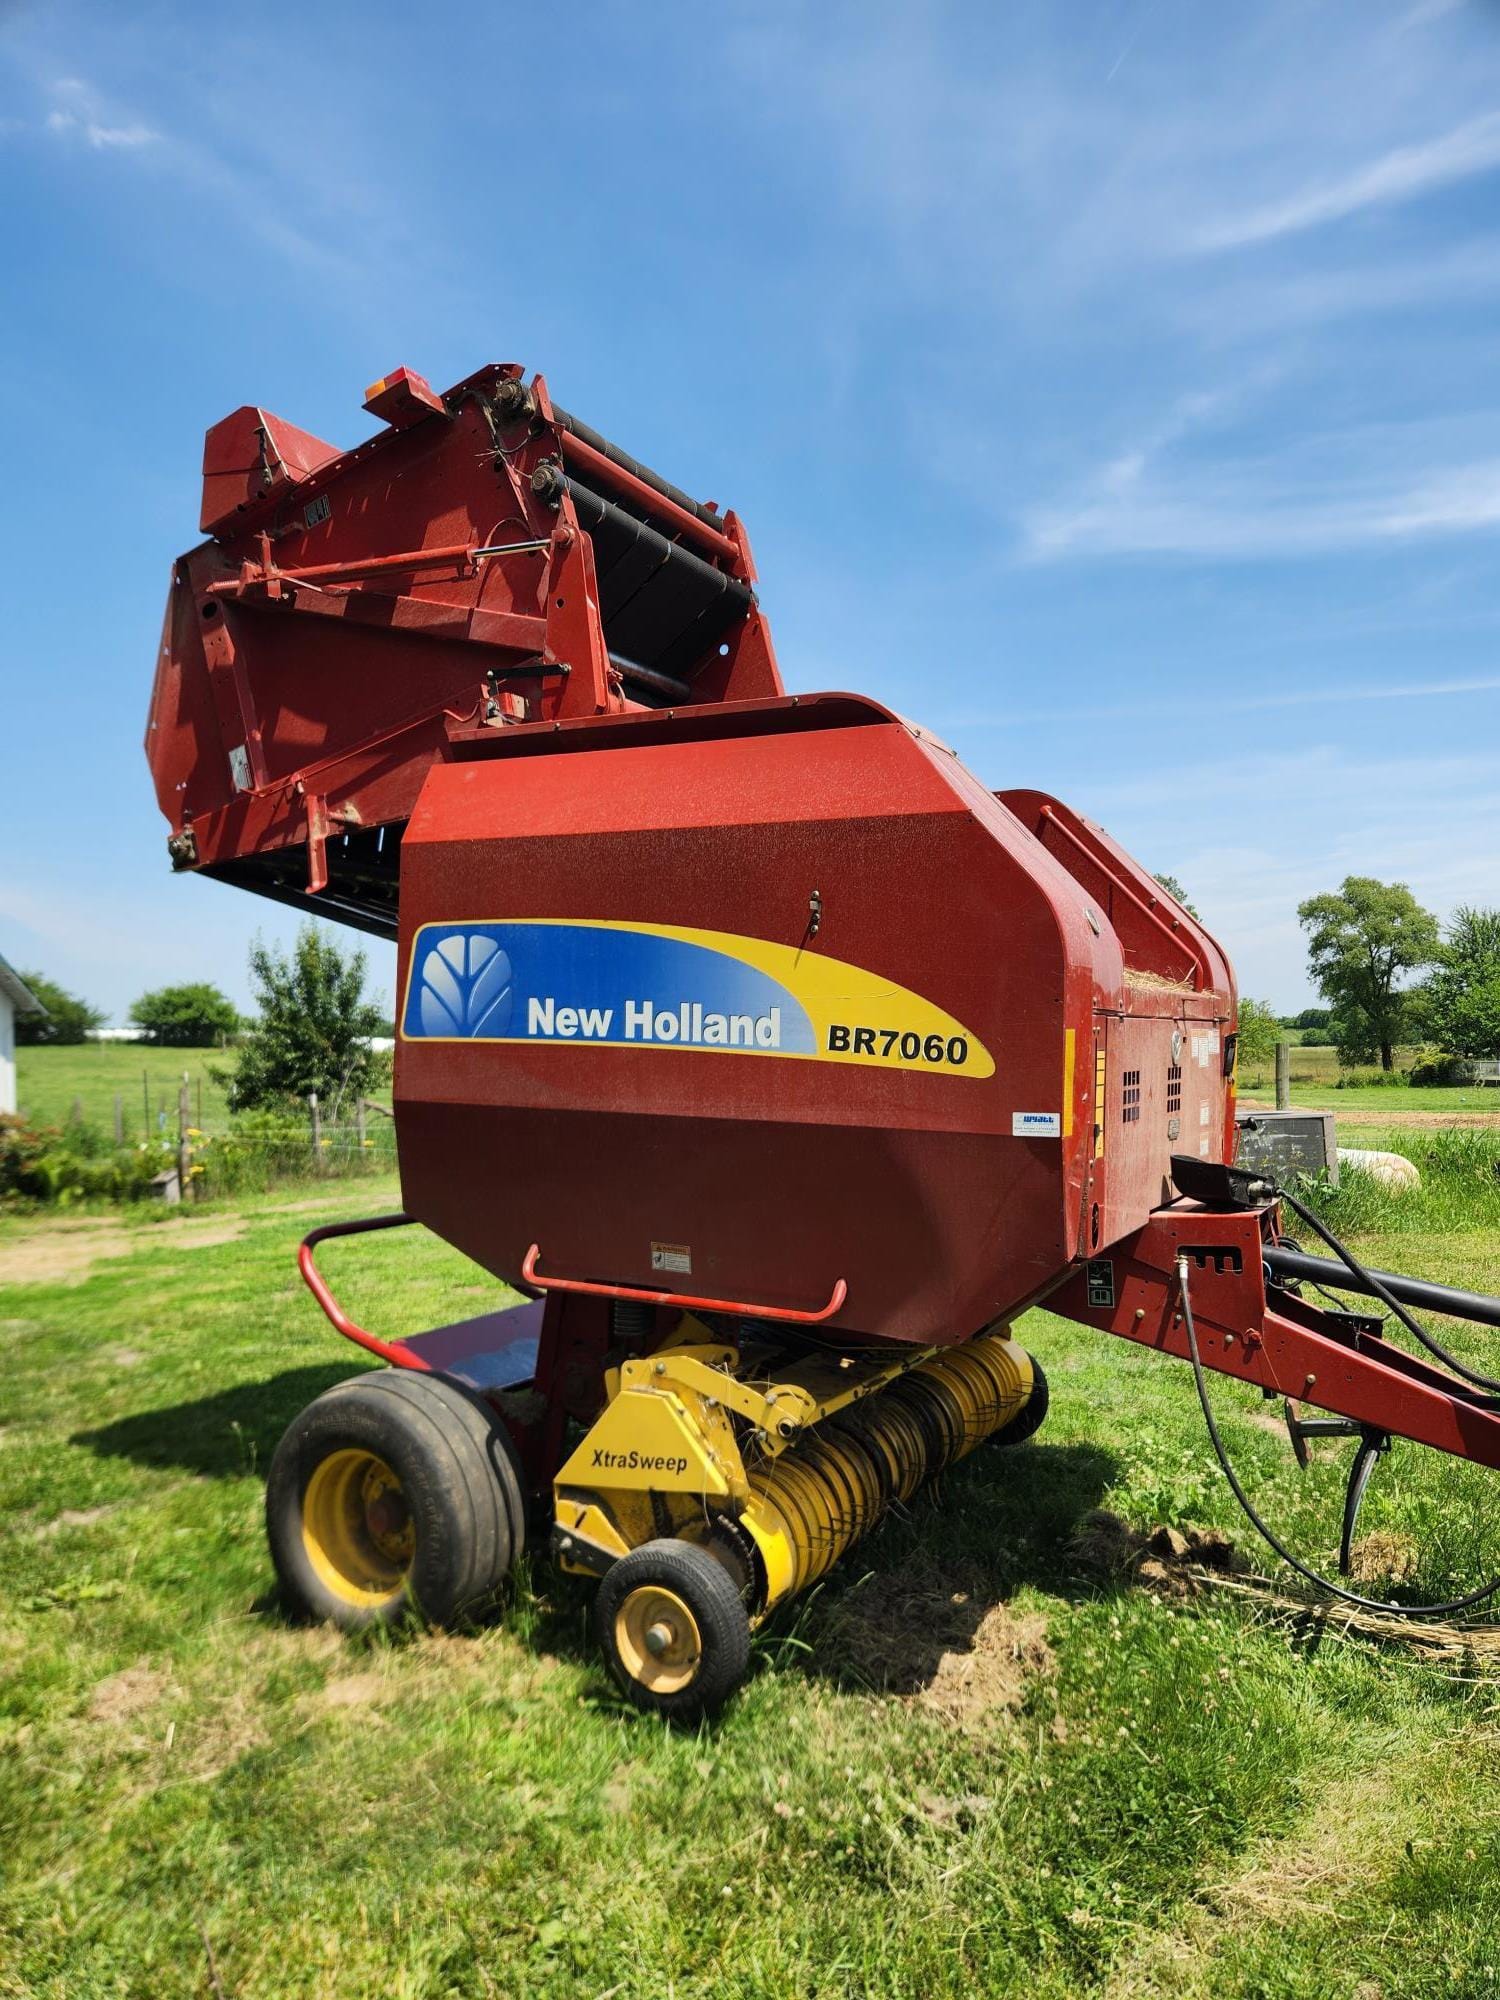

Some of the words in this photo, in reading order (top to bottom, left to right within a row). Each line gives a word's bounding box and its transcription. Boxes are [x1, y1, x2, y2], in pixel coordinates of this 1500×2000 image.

[528, 997, 614, 1038] New
[624, 1000, 780, 1048] Holland
[828, 1024, 968, 1065] BR7060
[591, 1449, 688, 1476] XtraSweep
